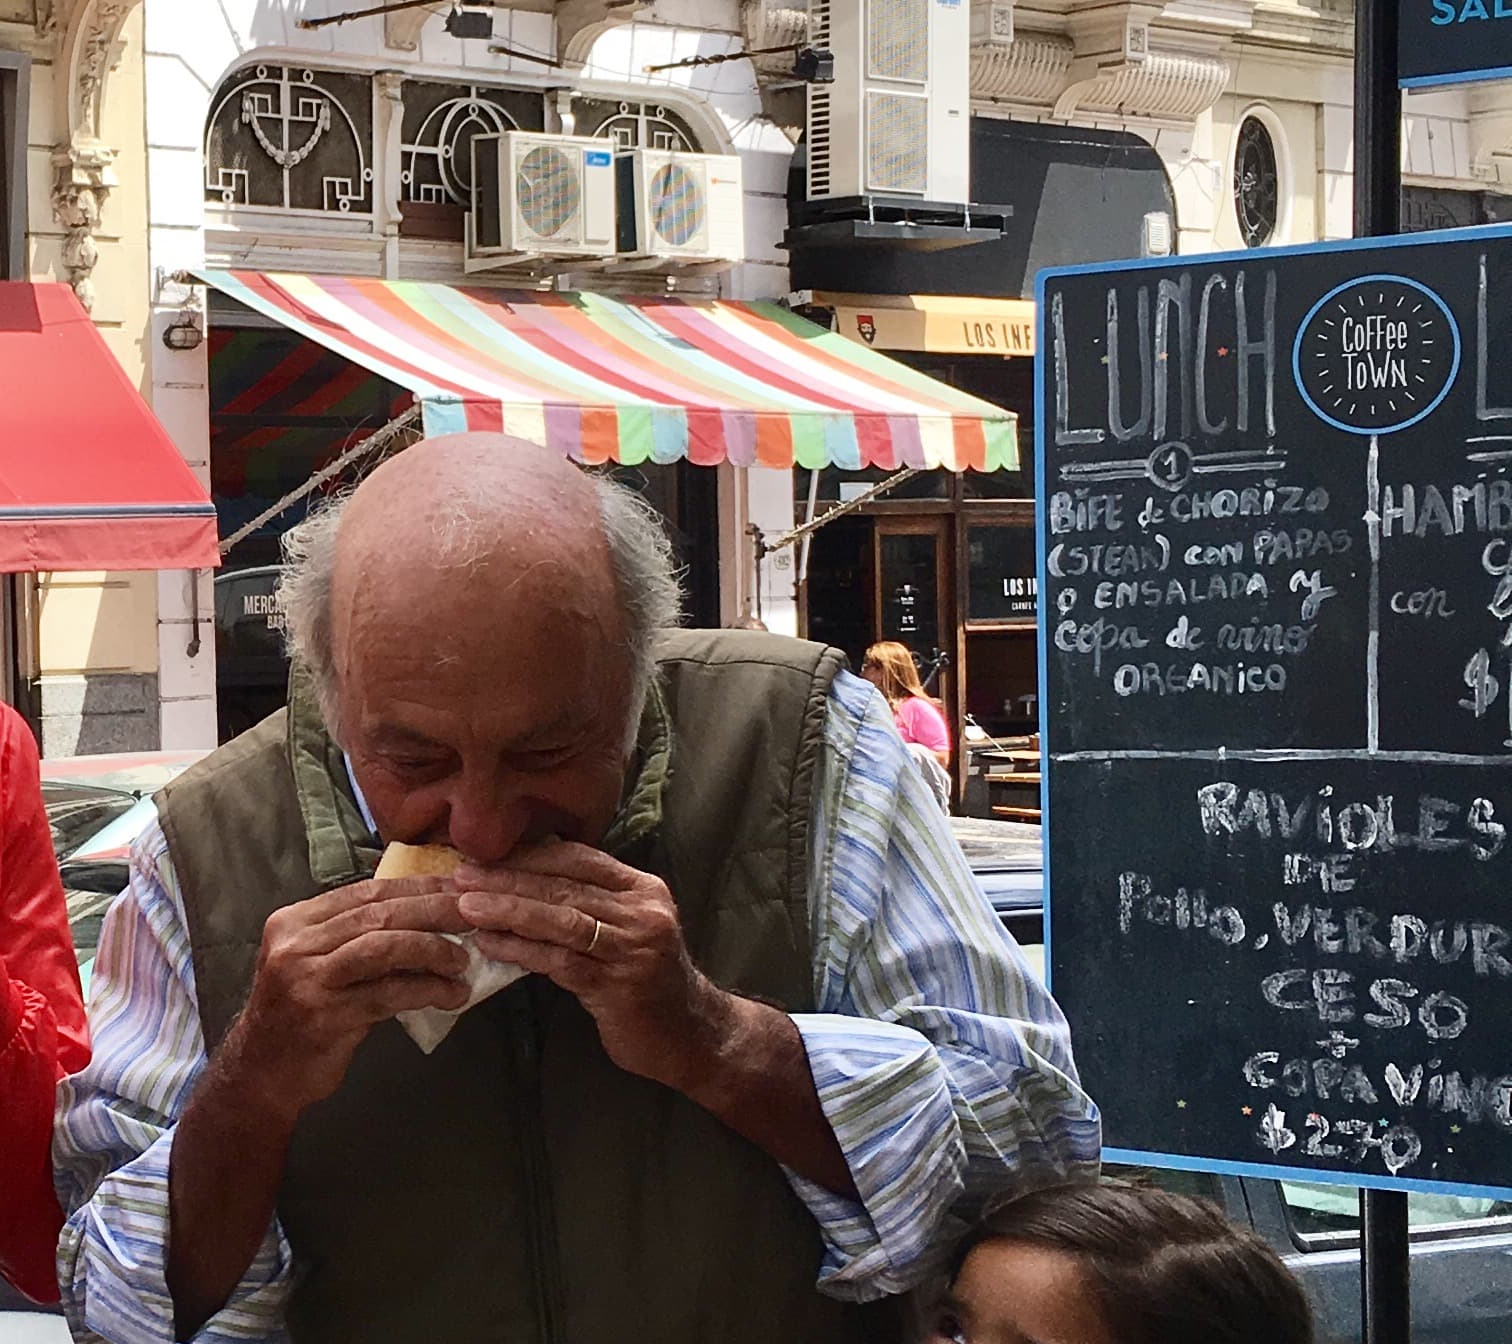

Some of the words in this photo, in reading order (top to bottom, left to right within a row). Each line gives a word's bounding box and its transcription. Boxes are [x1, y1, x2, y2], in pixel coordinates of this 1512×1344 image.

[963, 322, 995, 347] LOS
[1052, 270, 1276, 445] LUNCH
[1253, 528, 1353, 565] PAPAS
[1003, 578, 1023, 596] LOS
[1094, 572, 1268, 608] ENSALADA
[1166, 615, 1204, 650] de
[1261, 968, 1469, 1040] CESO
